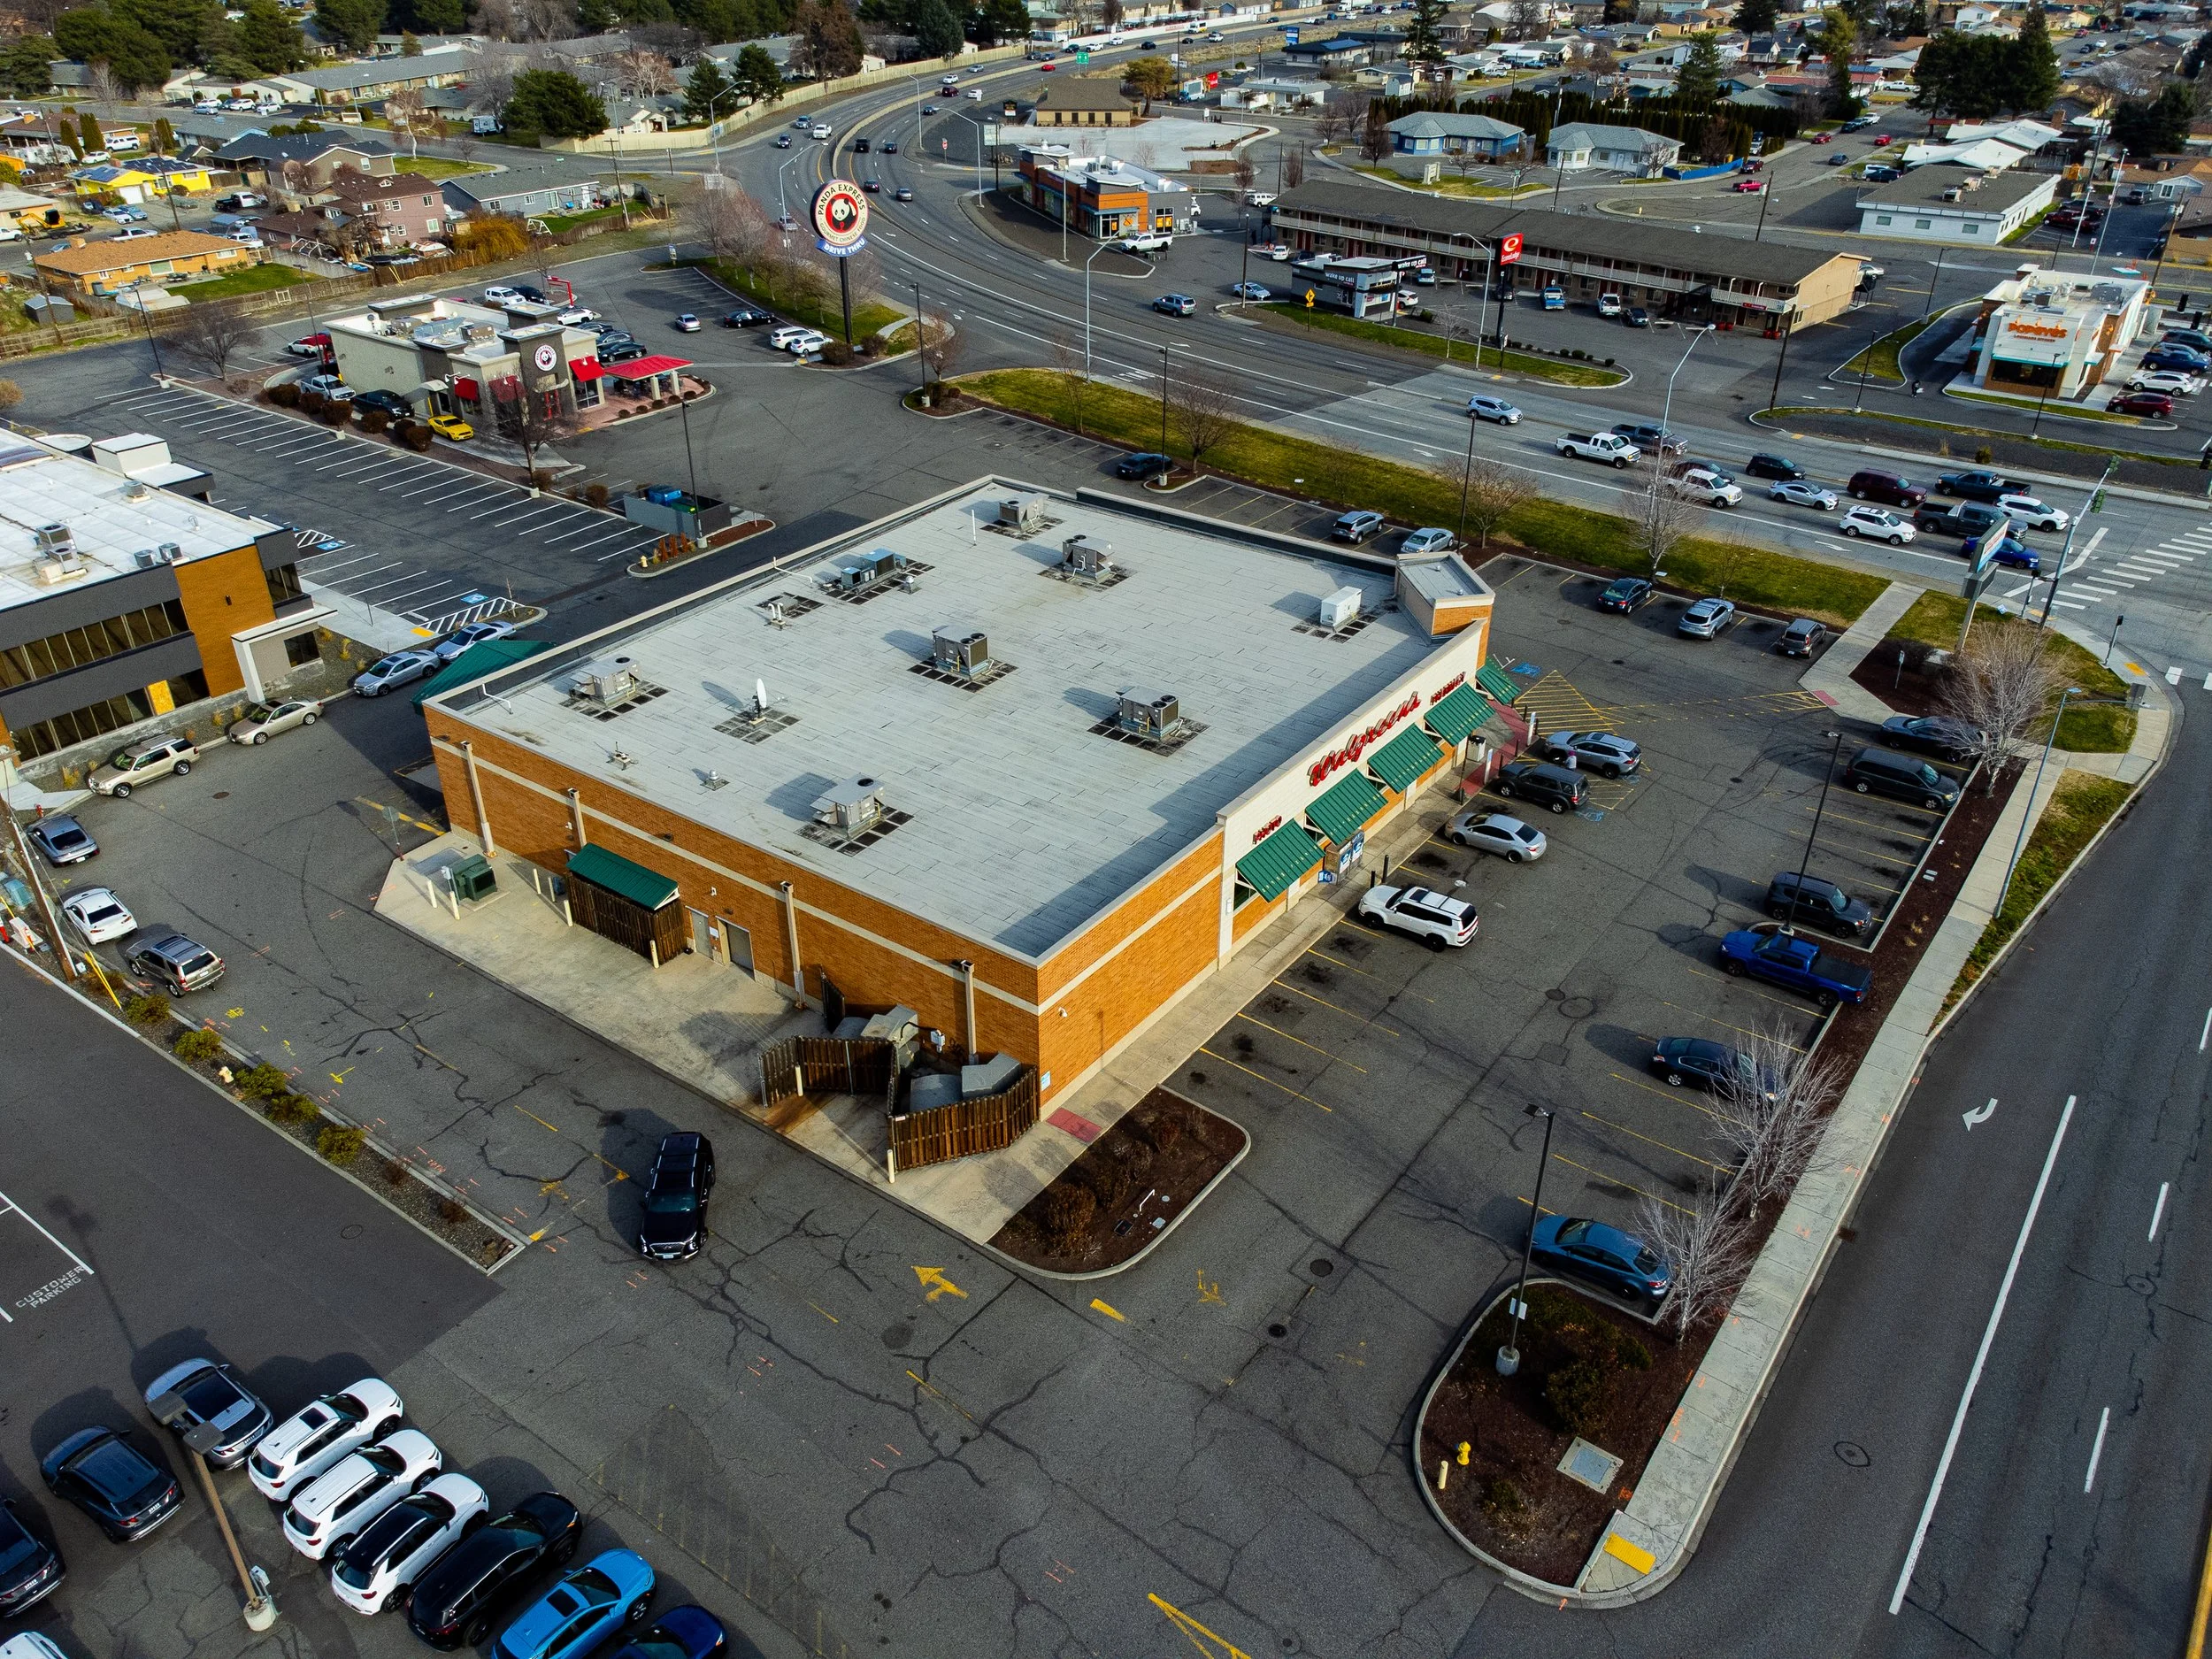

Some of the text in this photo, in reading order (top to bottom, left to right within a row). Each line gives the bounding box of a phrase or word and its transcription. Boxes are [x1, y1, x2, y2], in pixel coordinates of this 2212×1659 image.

[818, 184, 866, 215] PANDA EXPRESS
[819, 217, 866, 242] GOURMET CHINESE FOOD
[823, 239, 865, 255] DRIVE THRU
[2008, 322, 2068, 339] POPEYES
[1307, 691, 1422, 787] Walgreens
[15, 1265, 85, 1308] CUSTOMER
[30, 1276, 82, 1308] PARKING
